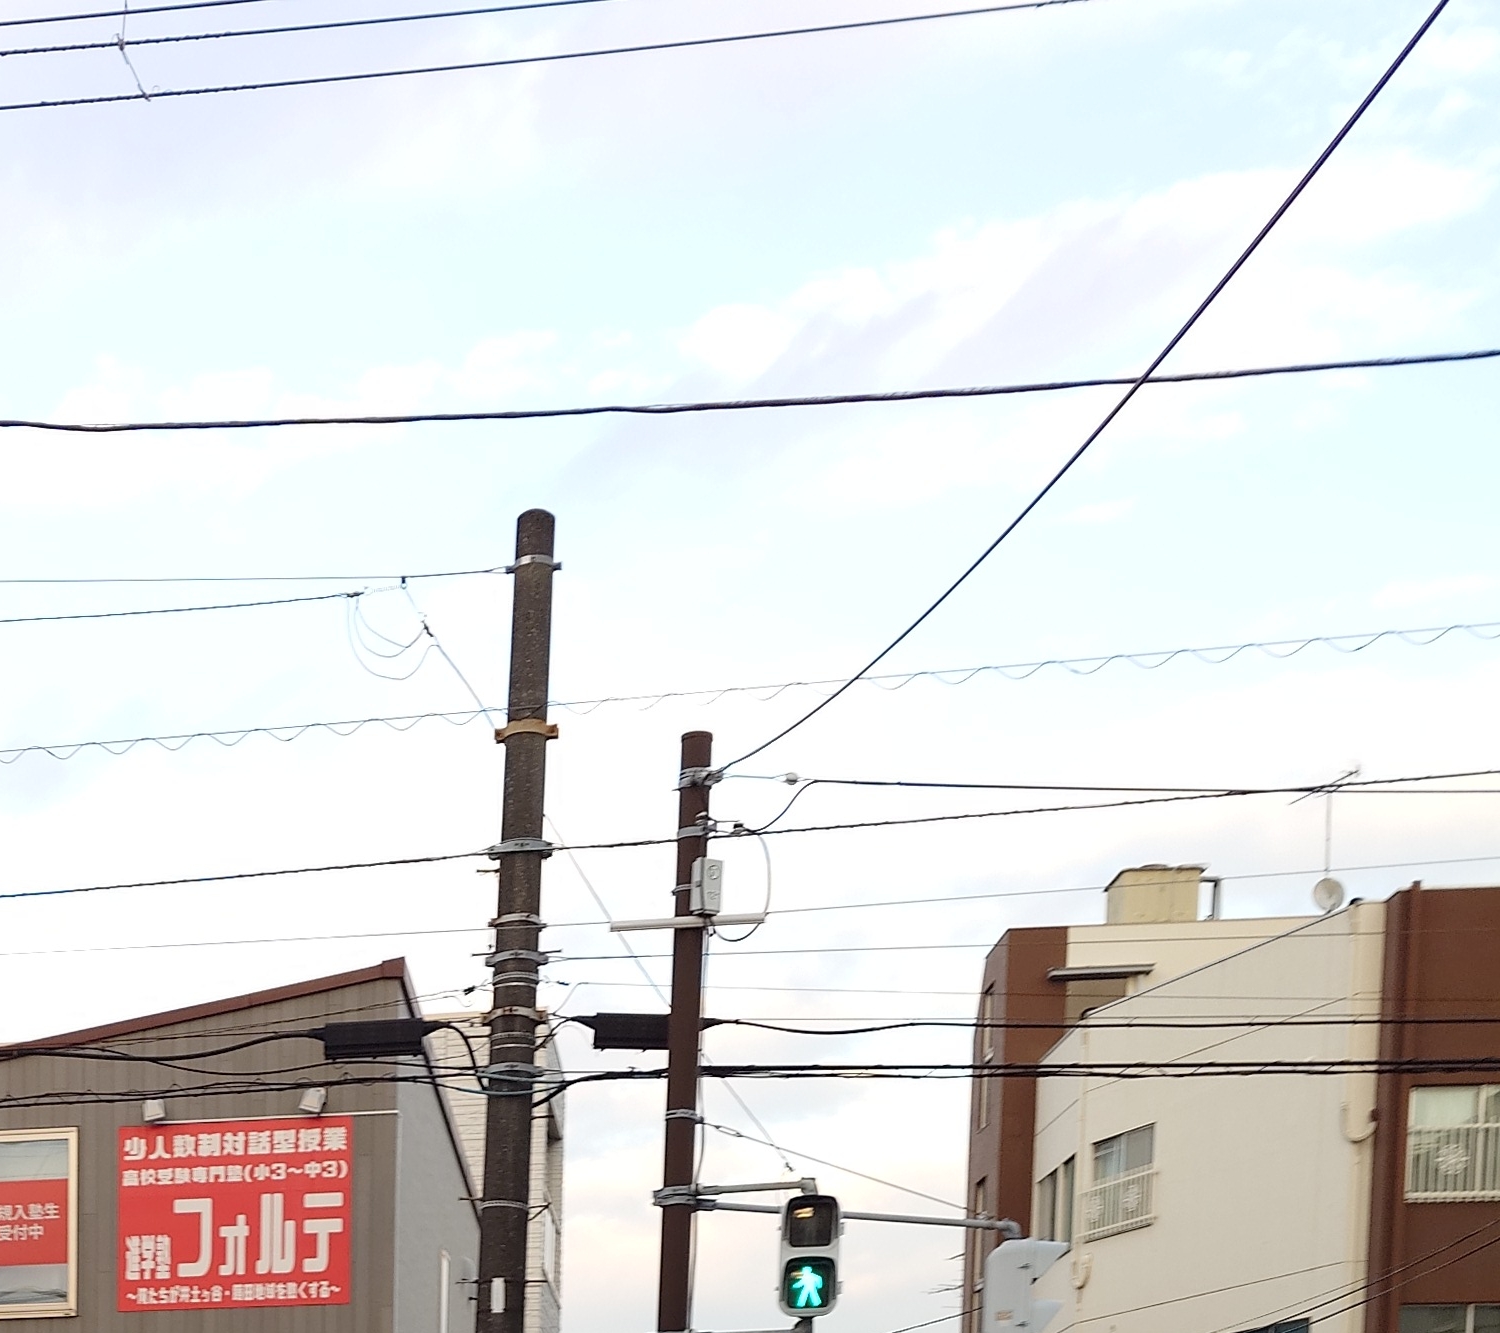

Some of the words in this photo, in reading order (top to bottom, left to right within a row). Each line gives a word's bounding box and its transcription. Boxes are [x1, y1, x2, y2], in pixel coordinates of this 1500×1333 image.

[123, 1127, 348, 1161] 少人数制対話型授業
[125, 1234, 171, 1280] 進学塾
[173, 1192, 344, 1278] フォルテ
